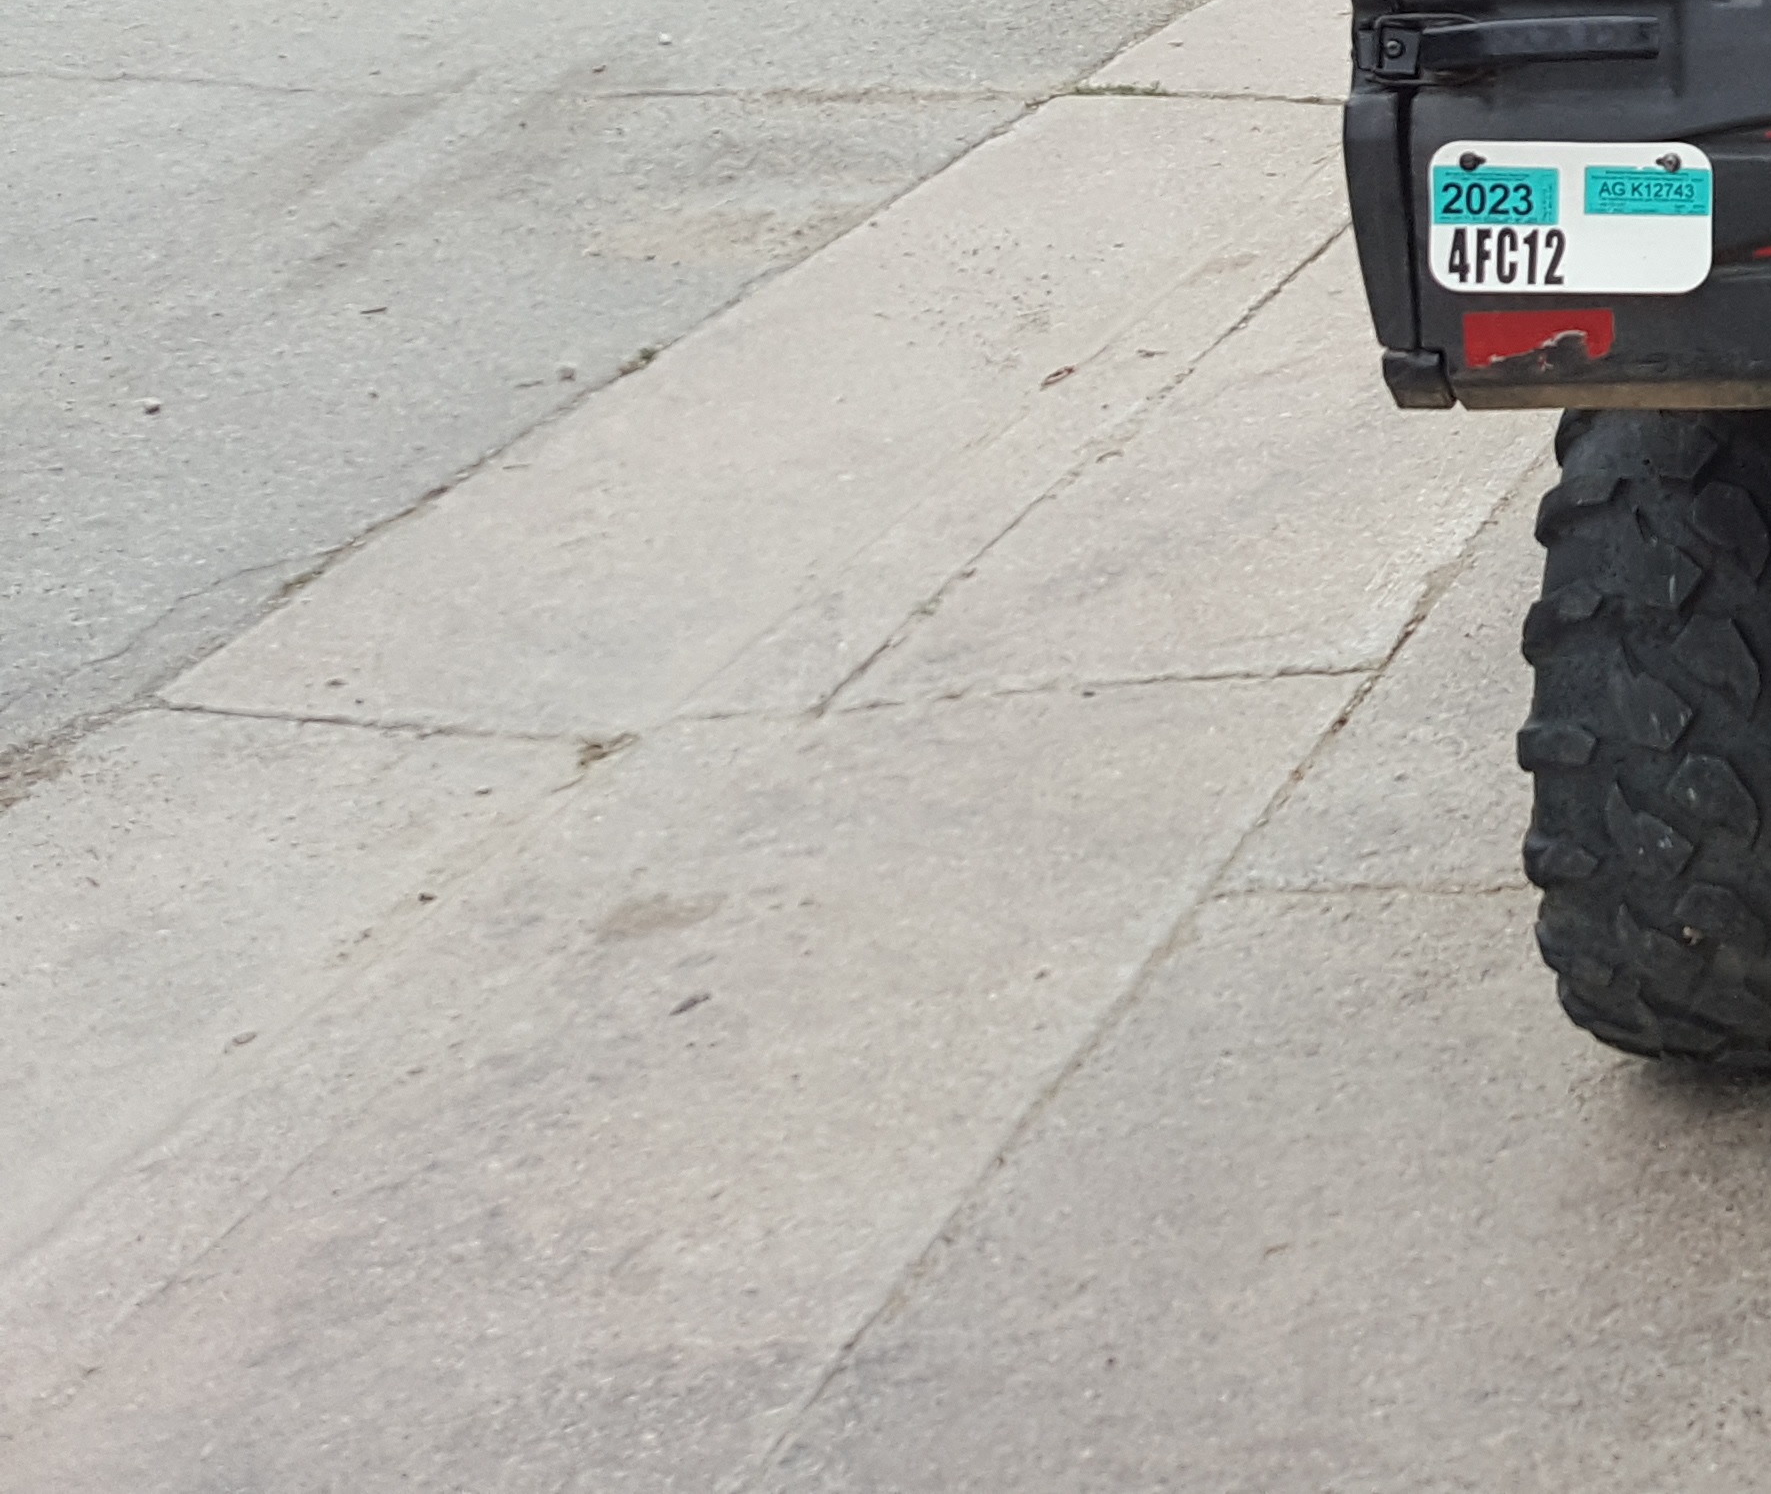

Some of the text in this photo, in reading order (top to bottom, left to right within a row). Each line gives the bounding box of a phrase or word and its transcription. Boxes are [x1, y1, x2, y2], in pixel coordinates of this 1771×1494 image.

[1441, 182, 1534, 216] 2023
[1600, 181, 1695, 199] AG K12743
[1448, 227, 1567, 285] 4FC12
